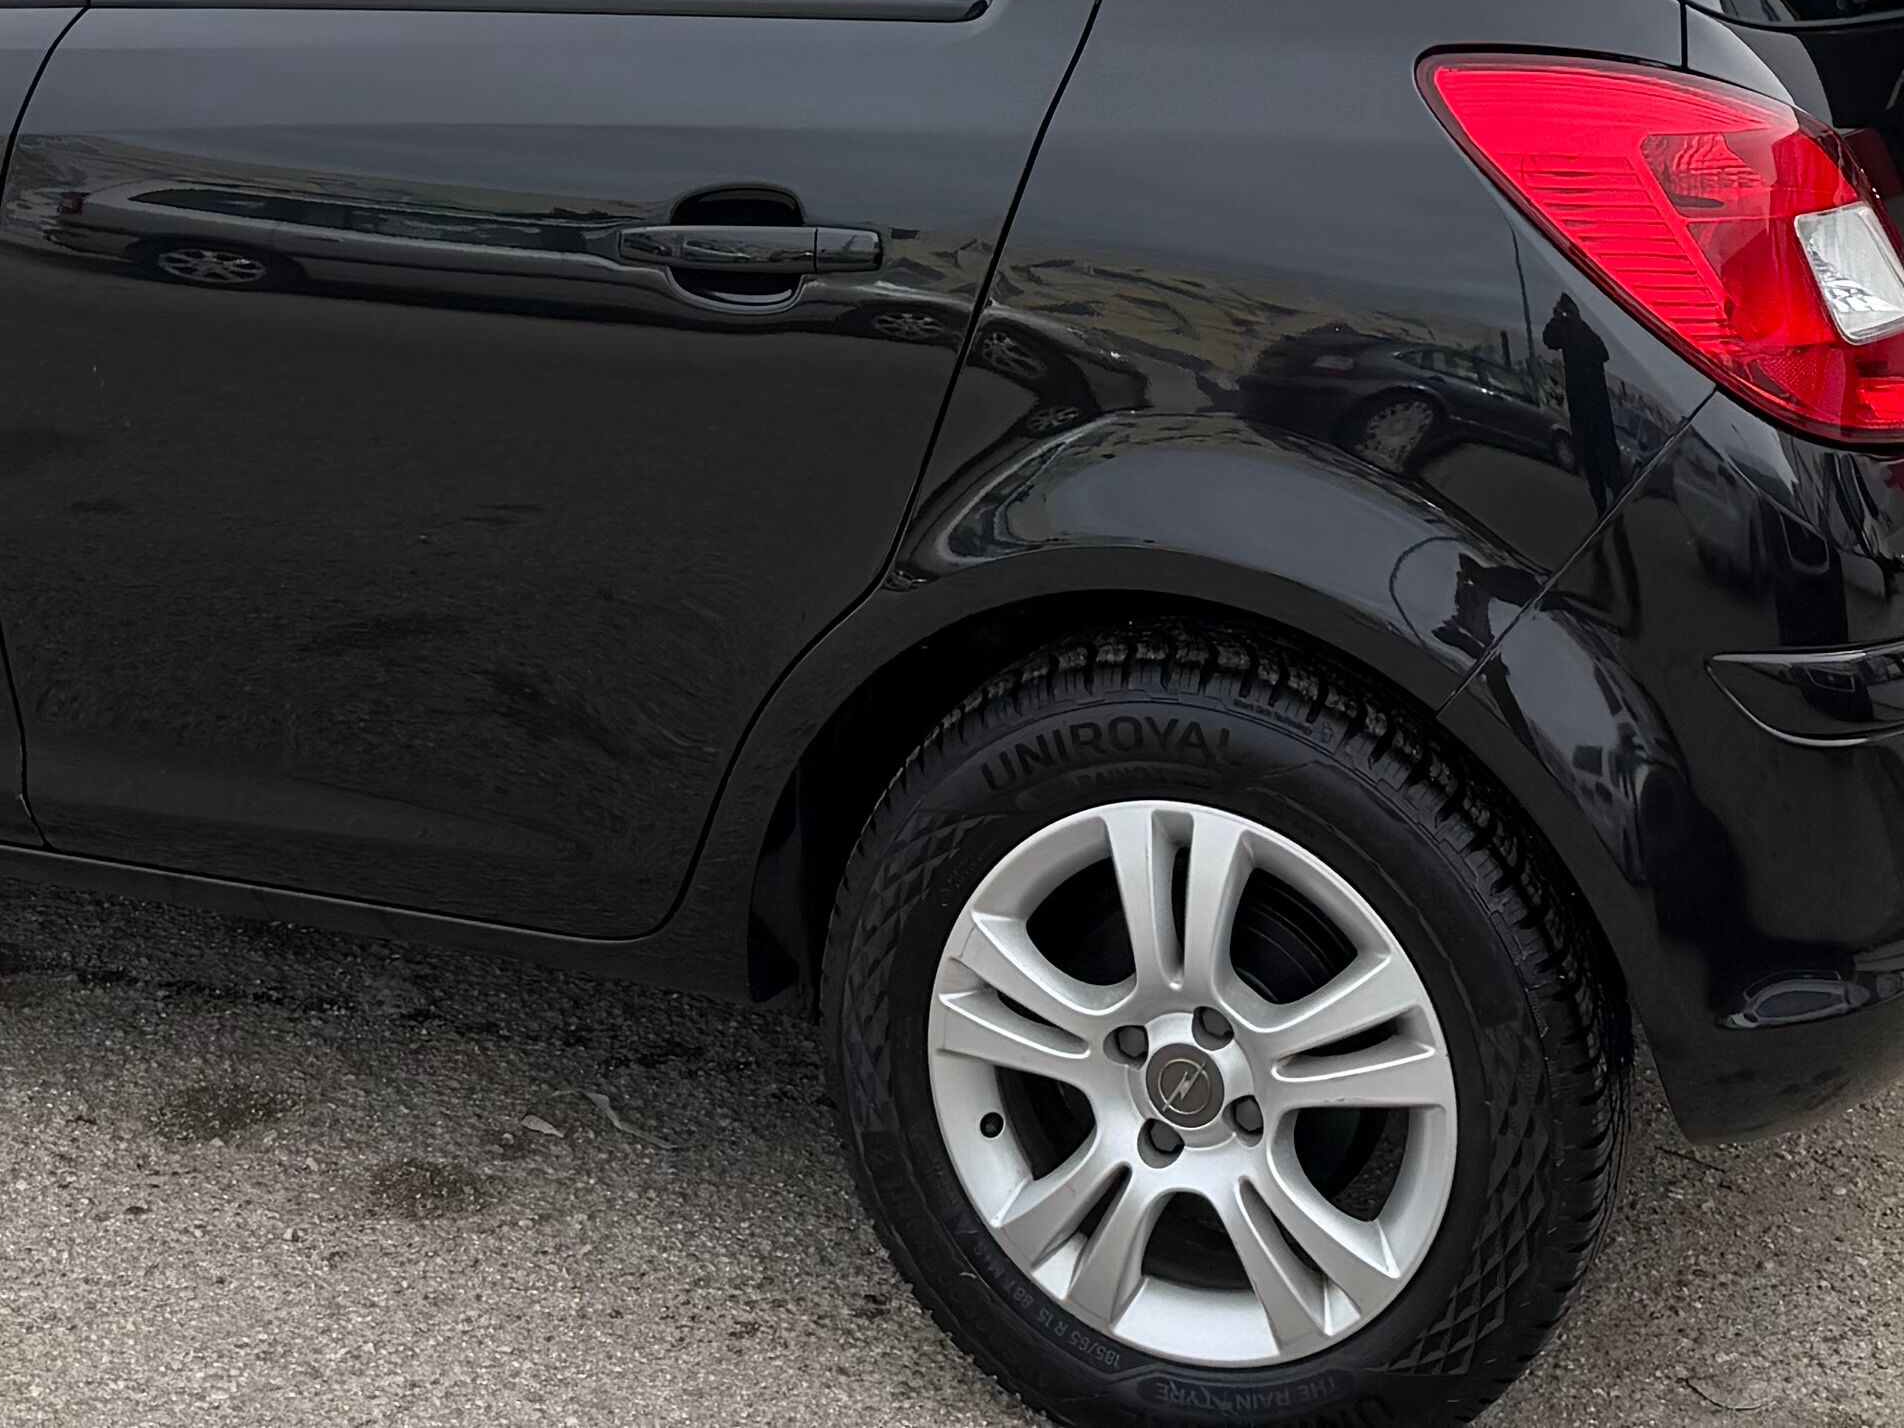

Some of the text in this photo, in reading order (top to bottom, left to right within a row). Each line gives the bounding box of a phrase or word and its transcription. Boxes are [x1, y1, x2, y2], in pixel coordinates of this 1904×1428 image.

[981, 715, 1233, 792] UNIROYAL
[1054, 1321, 1069, 1338] R
[1235, 1387, 1290, 1410] RAIN
[1296, 1375, 1336, 1400] THE
